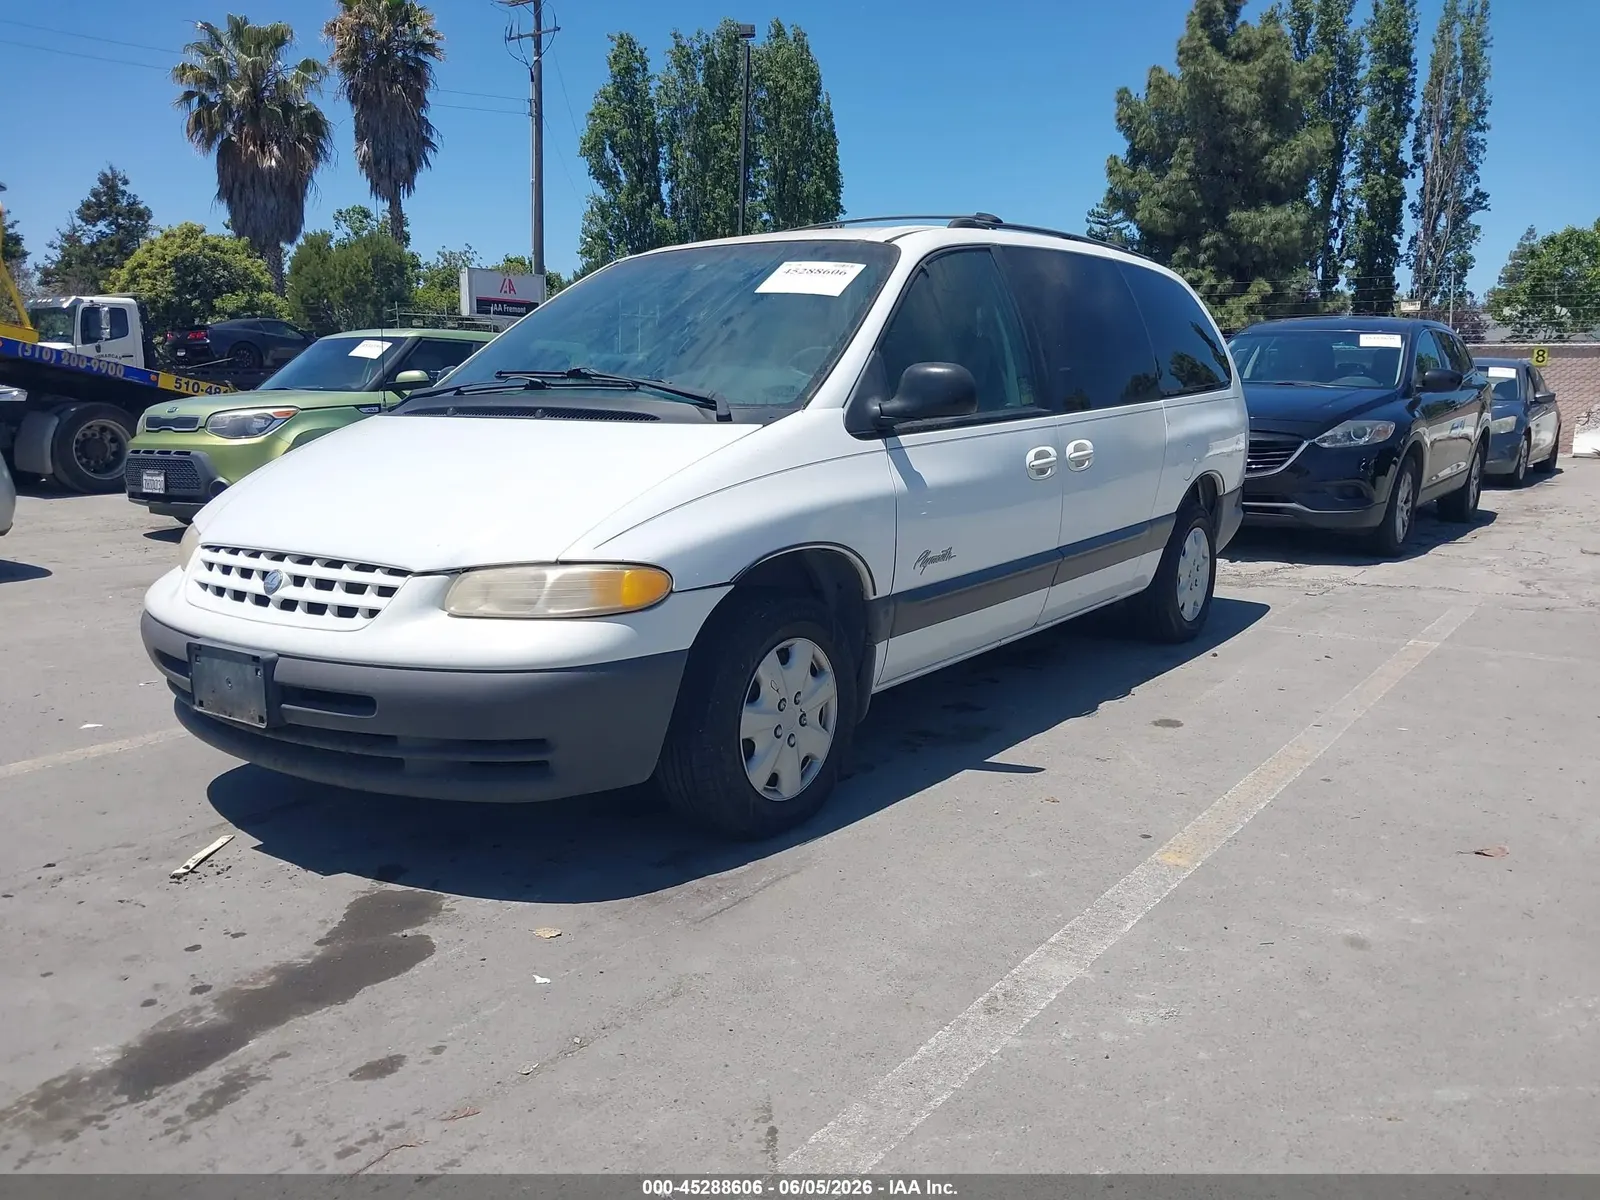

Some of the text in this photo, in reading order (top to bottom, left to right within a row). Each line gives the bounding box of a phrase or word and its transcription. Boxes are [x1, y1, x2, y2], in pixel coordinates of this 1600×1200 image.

[783, 268, 847, 276] 45288606
[503, 304, 527, 314] Fremont
[17, 342, 125, 378] (510) 200-9900
[1535, 349, 1546, 363] 8
[912, 546, 957, 576] Plymouth
